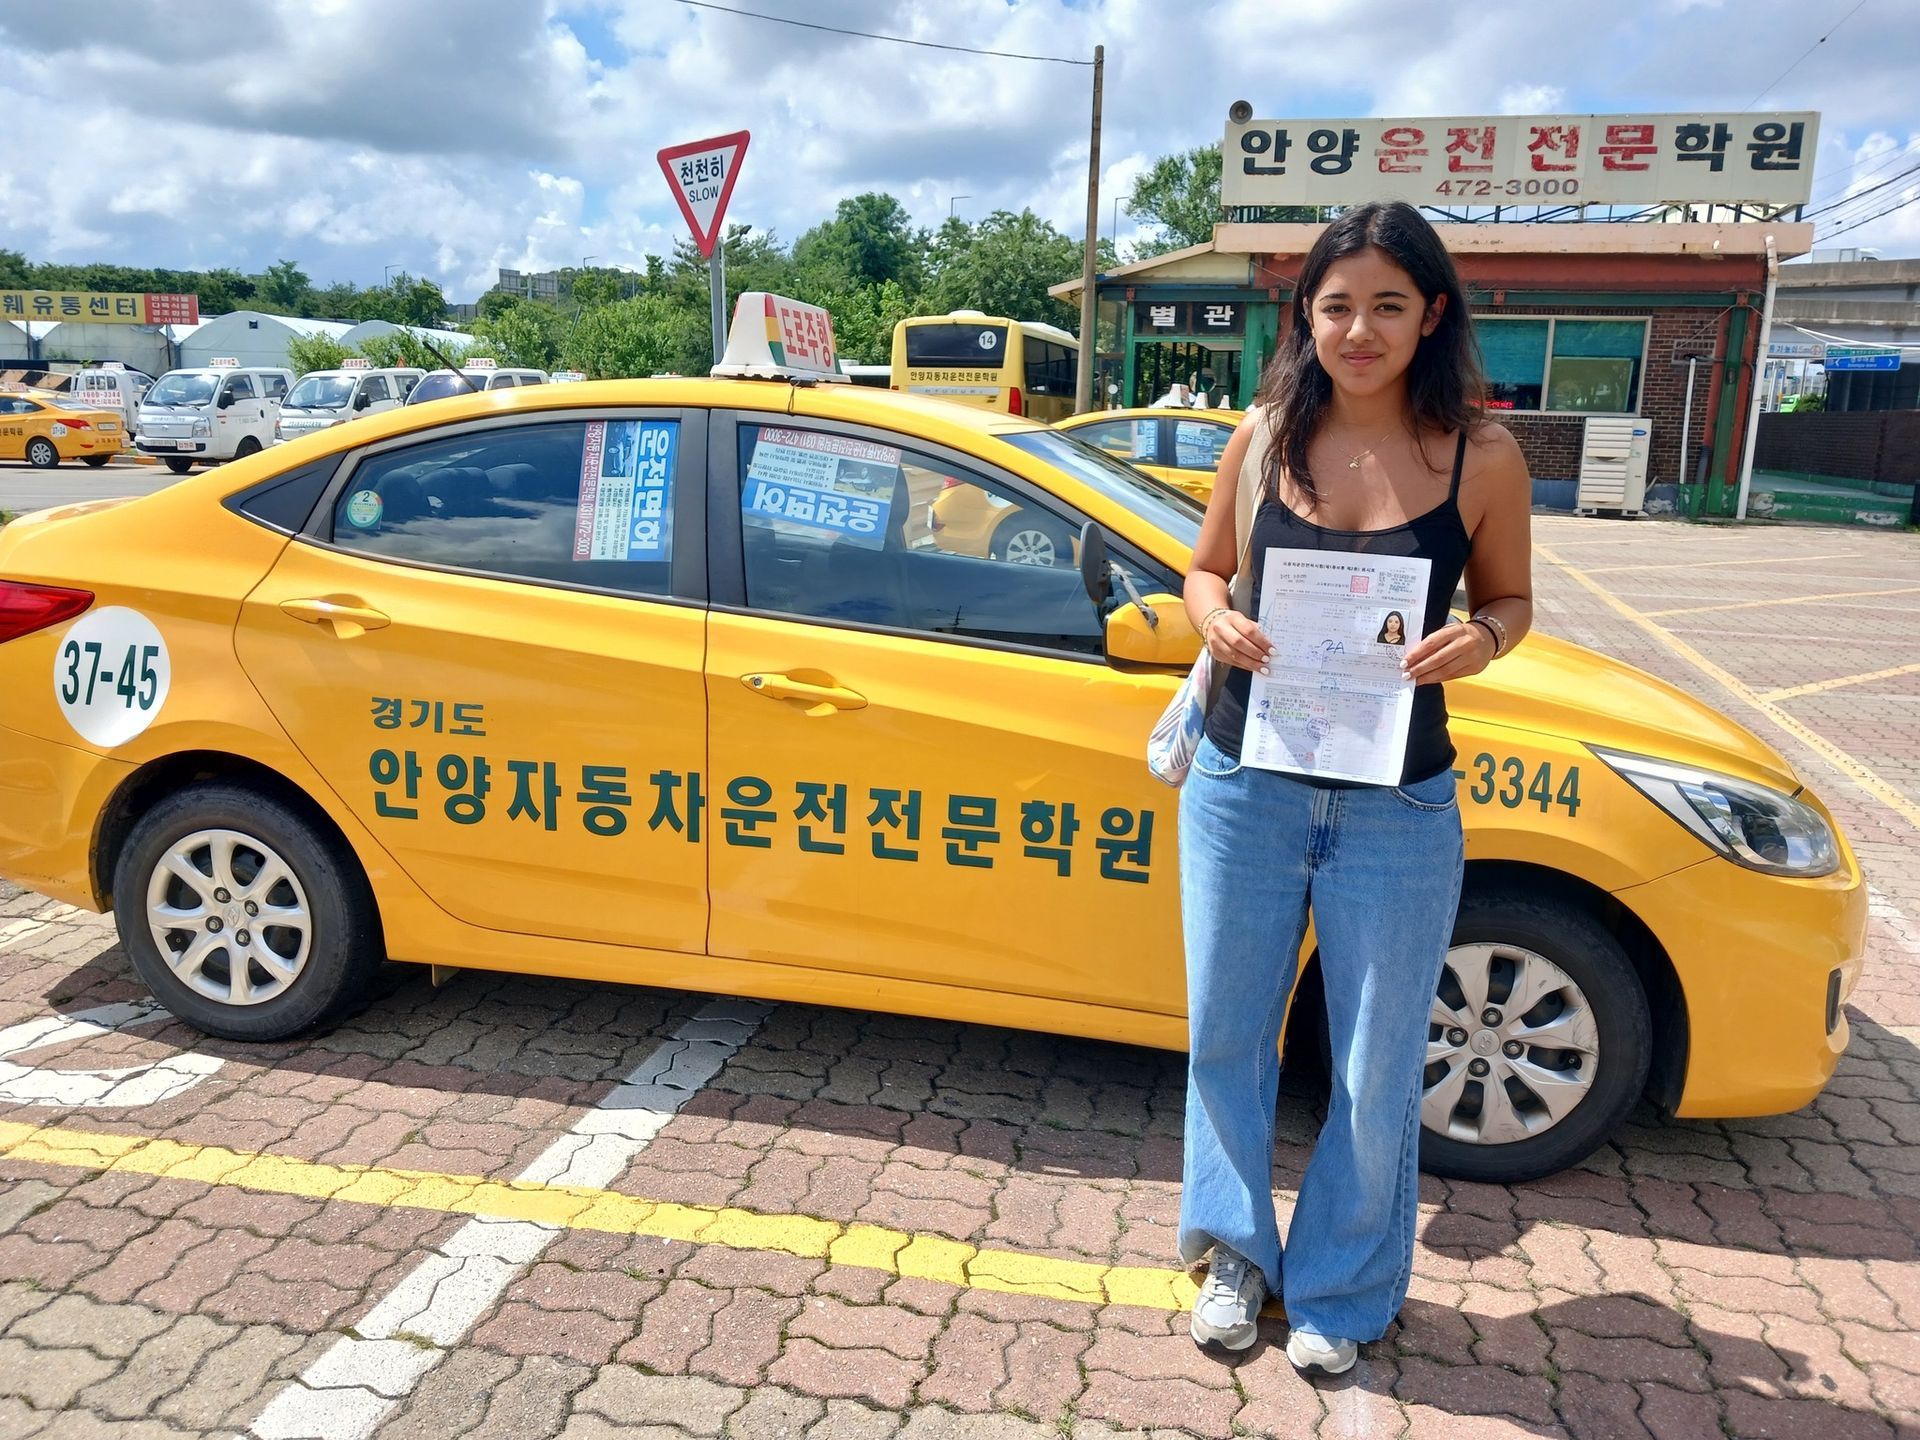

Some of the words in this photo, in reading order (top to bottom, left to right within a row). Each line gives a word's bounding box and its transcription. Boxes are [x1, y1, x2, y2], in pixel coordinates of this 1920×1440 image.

[680, 153, 725, 186] 천천히
[689, 185, 719, 204] SLOW
[1435, 179, 1580, 197] 472-3000
[781, 307, 834, 367] 도로주행
[980, 335, 994, 346] 14
[910, 371, 998, 382] 안양자동차운전전문학원
[765, 428, 799, 443] 472-3000
[818, 436, 896, 462] 안양자동차운전전문학원
[582, 424, 603, 501] 안양자동차운전전문학원
[362, 491, 370, 503] 2
[631, 429, 669, 549] 운전면허
[753, 483, 879, 532] 운전면허
[577, 520, 591, 554] 472-3000
[61, 640, 160, 710] 37-45
[370, 696, 486, 737] 경기도
[369, 748, 1154, 884] 안양자동차운전전문학원
